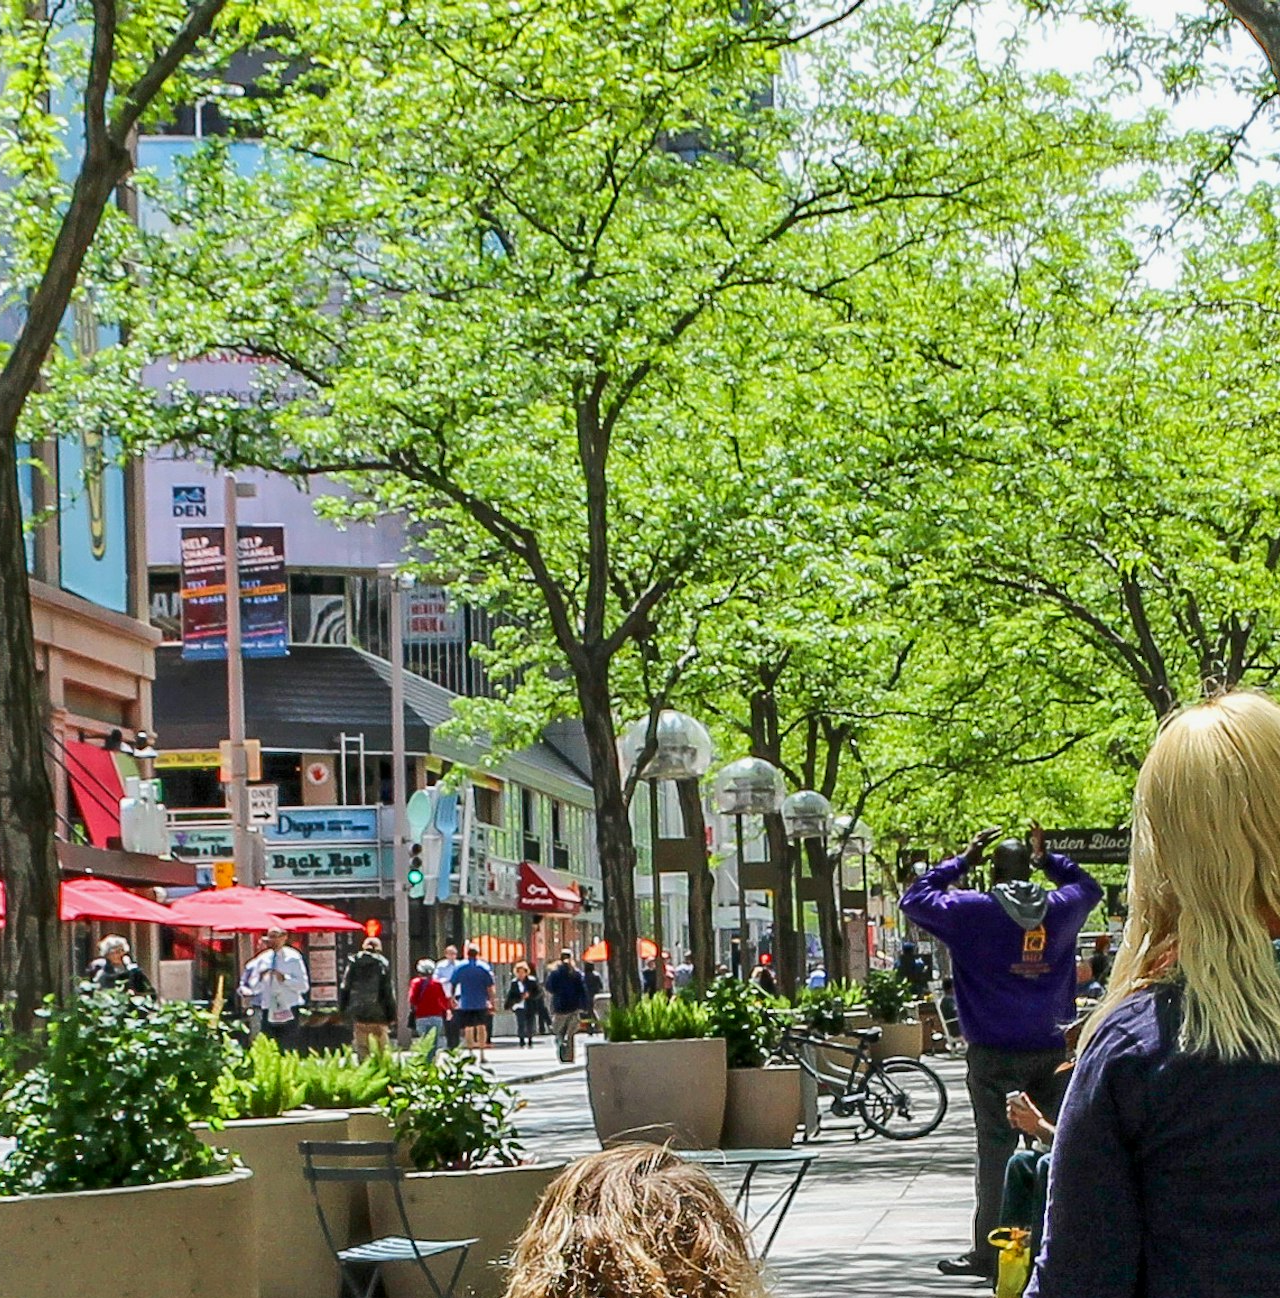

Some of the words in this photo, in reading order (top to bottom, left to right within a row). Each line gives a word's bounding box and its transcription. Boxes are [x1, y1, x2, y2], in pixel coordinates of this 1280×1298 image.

[173, 505, 207, 517] DEN
[251, 788, 273, 799] ONE
[252, 801, 272, 809] WAY
[272, 854, 321, 868] Back
[328, 853, 372, 867] East
